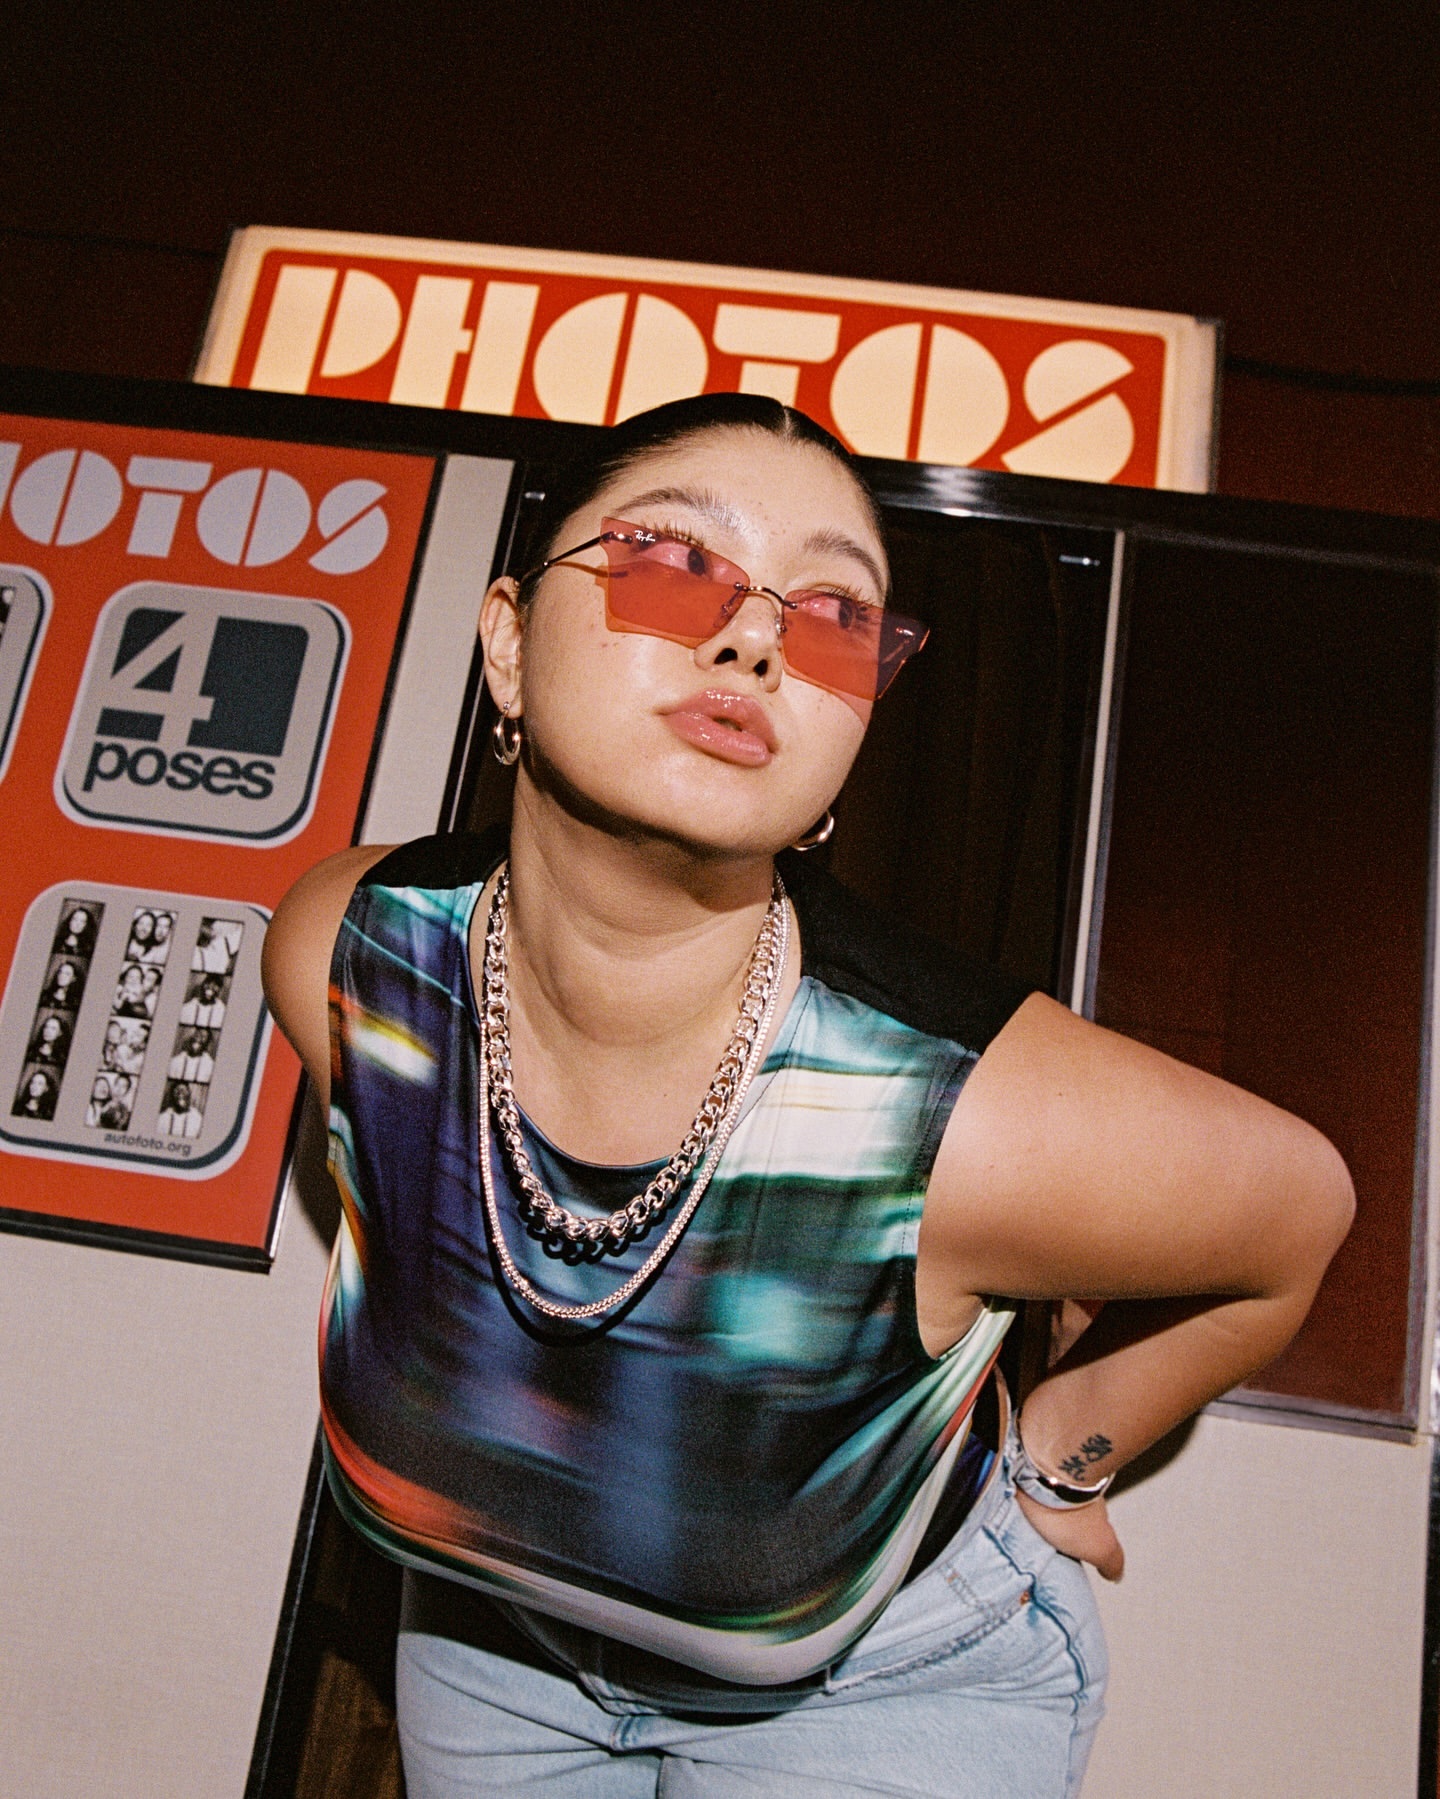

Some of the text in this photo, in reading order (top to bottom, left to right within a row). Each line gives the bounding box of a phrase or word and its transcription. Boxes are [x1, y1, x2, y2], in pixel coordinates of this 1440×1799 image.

[249, 264, 1135, 484] PHOTOS
[102, 610, 215, 746] 4
[82, 741, 276, 800] poses
[104, 1133, 192, 1157] autofoto.org
